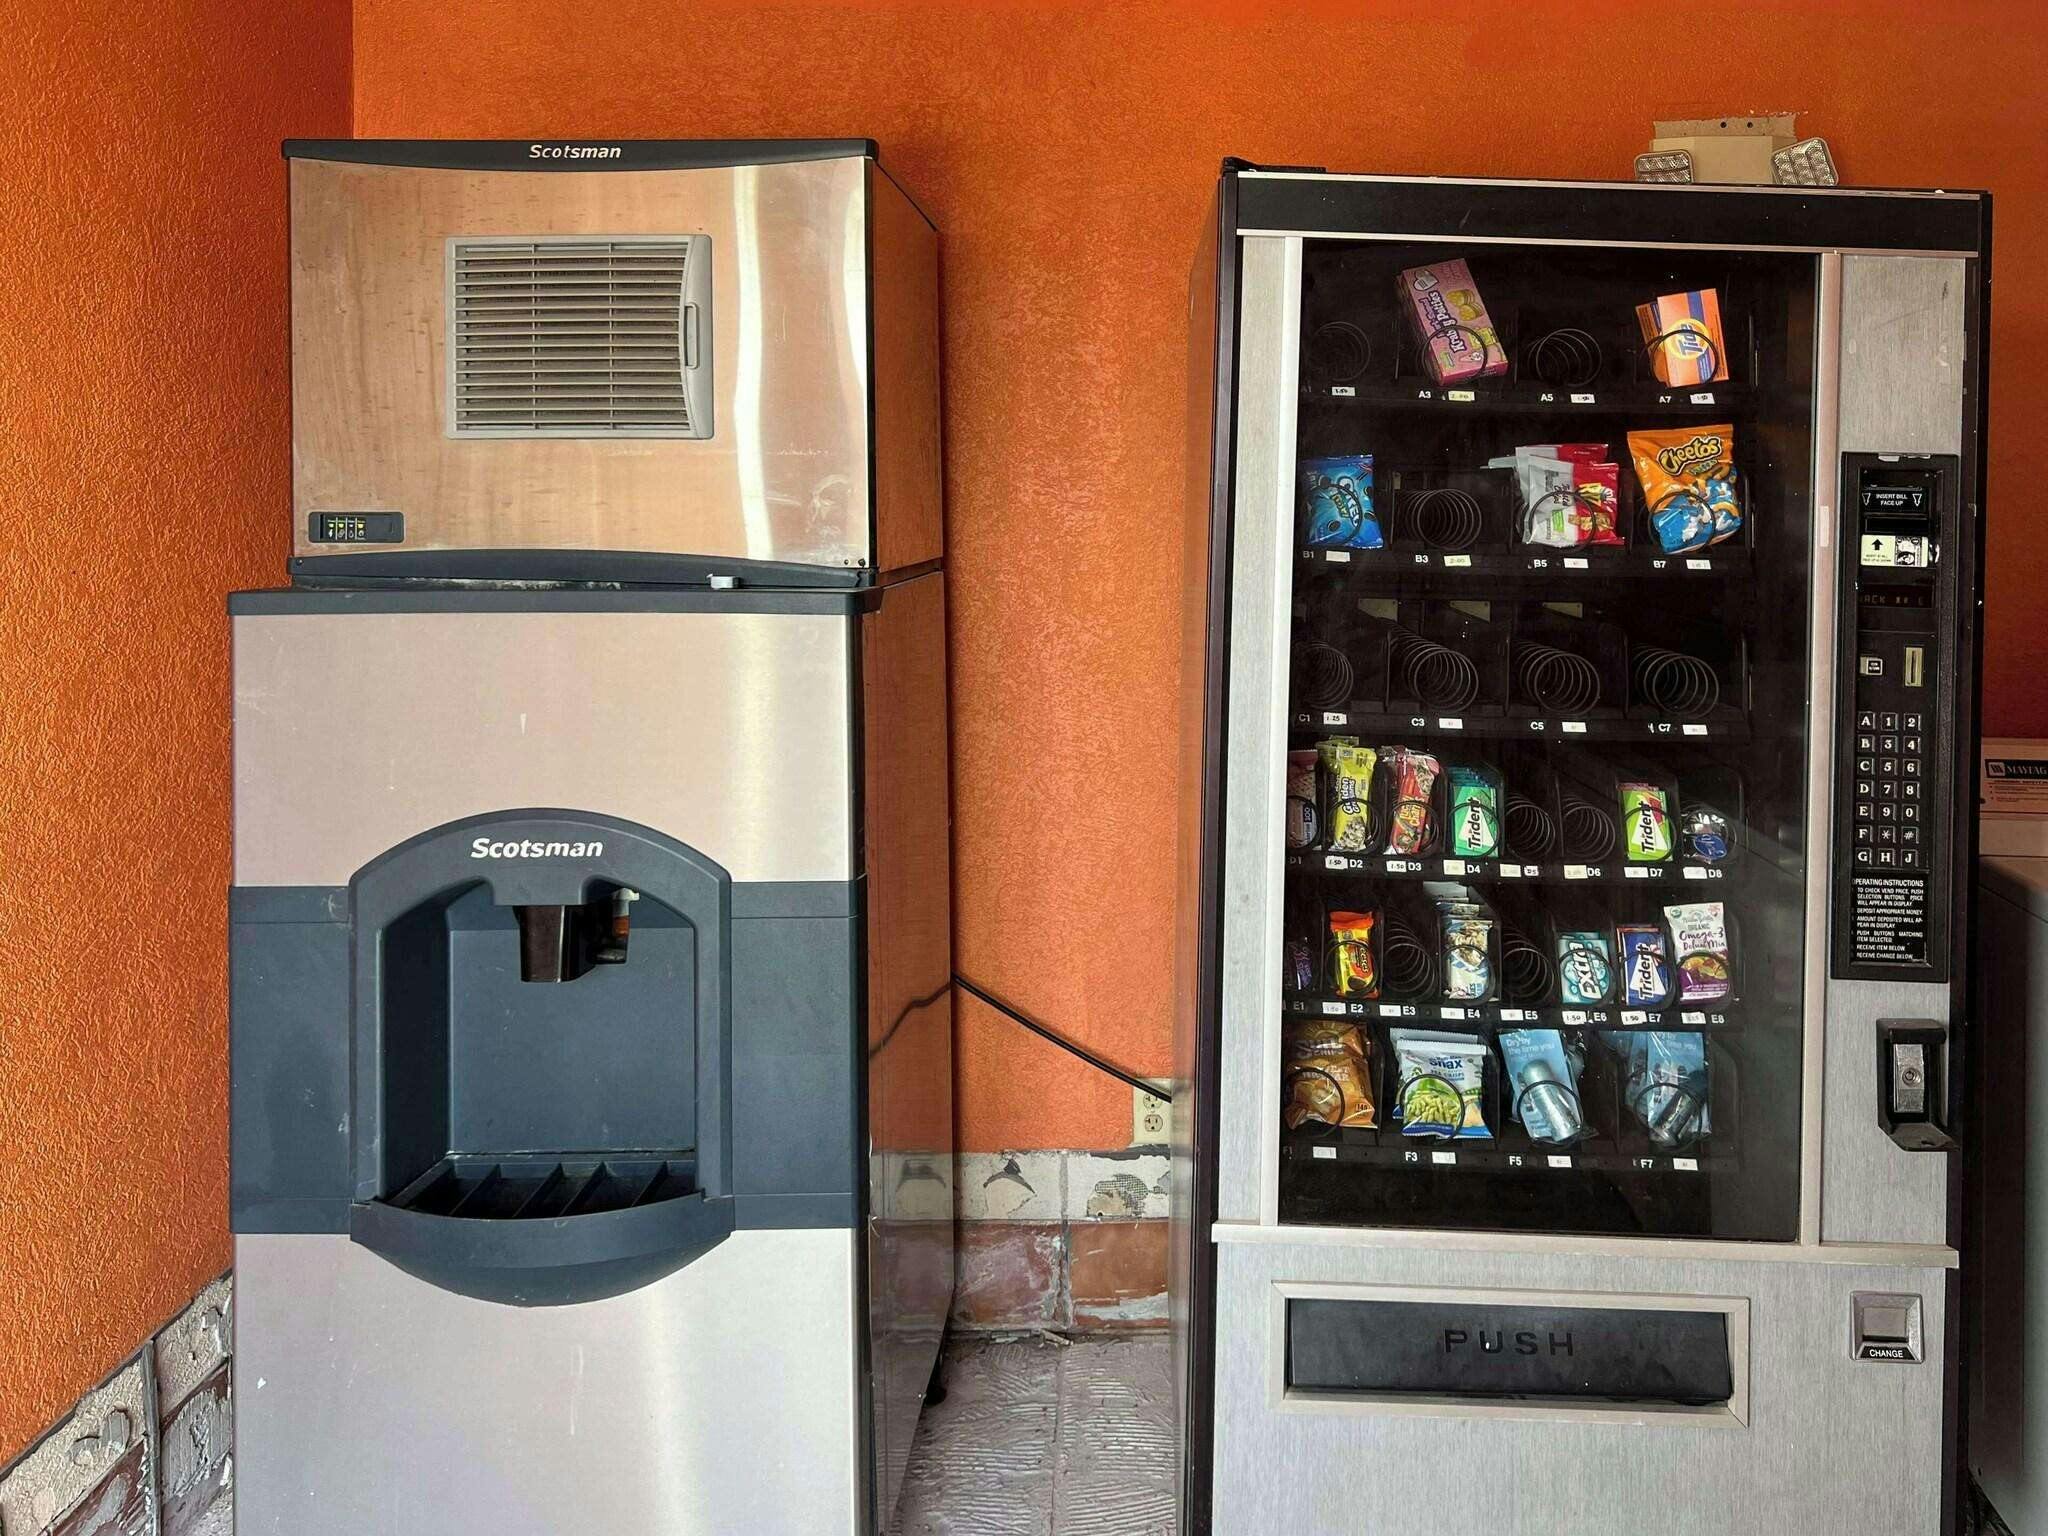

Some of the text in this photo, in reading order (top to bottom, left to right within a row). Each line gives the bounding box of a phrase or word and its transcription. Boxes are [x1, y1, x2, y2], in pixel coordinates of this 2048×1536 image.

[528, 144, 622, 160] Scotsman
[1418, 391, 1431, 399] A3
[1540, 393, 1554, 402] A5
[1659, 396, 1672, 404] A7
[1659, 437, 1720, 474] Cheetos
[1415, 555, 1429, 563] B3
[1534, 559, 1548, 567] B5
[1653, 560, 1666, 568] B7
[1299, 714, 1310, 722] C1
[1411, 718, 1425, 727] C3
[1861, 717, 1915, 728] A 1 2
[1530, 721, 1544, 730] C5
[1658, 723, 1672, 732] C7
[1861, 739, 1915, 750] B 3 4
[1860, 761, 1915, 773] C 5 6
[2007, 765, 2047, 775] MAYTAG
[1859, 784, 1914, 795] D 7 8
[1859, 807, 1913, 817] E 9 0
[1468, 797, 1481, 849] Trident
[1638, 801, 1655, 854] Trident
[1859, 829, 1868, 838] F
[470, 837, 604, 859] Scotsman
[1289, 857, 1302, 865] D1
[1858, 852, 1912, 863] G H J
[1349, 860, 1364, 868] D2
[1408, 863, 1421, 871] D3
[1467, 865, 1481, 873] D4
[1588, 868, 1601, 876] D6
[1650, 868, 1663, 877] D7
[1708, 869, 1722, 878] D8
[1883, 879, 1924, 887] INSTRUCTIONS
[1679, 927, 1724, 942] Omega-3
[1638, 943, 1655, 1000] Trident
[1293, 1001, 1305, 1010] E1
[1350, 1003, 1364, 1013] E2
[1402, 1007, 1416, 1016] E3
[1467, 1009, 1480, 1018] E4
[1525, 1010, 1538, 1020] E5
[1593, 1012, 1607, 1022] E6
[1648, 1013, 1662, 1022] E7
[1711, 1015, 1724, 1024] E8
[1429, 1059, 1463, 1070] Snax
[1405, 1151, 1418, 1161] F3
[1509, 1155, 1522, 1166] F5
[1640, 1159, 1653, 1169] F7
[1443, 1329, 1574, 1357] PUSH
[1869, 1348, 1904, 1359] CHANGE
